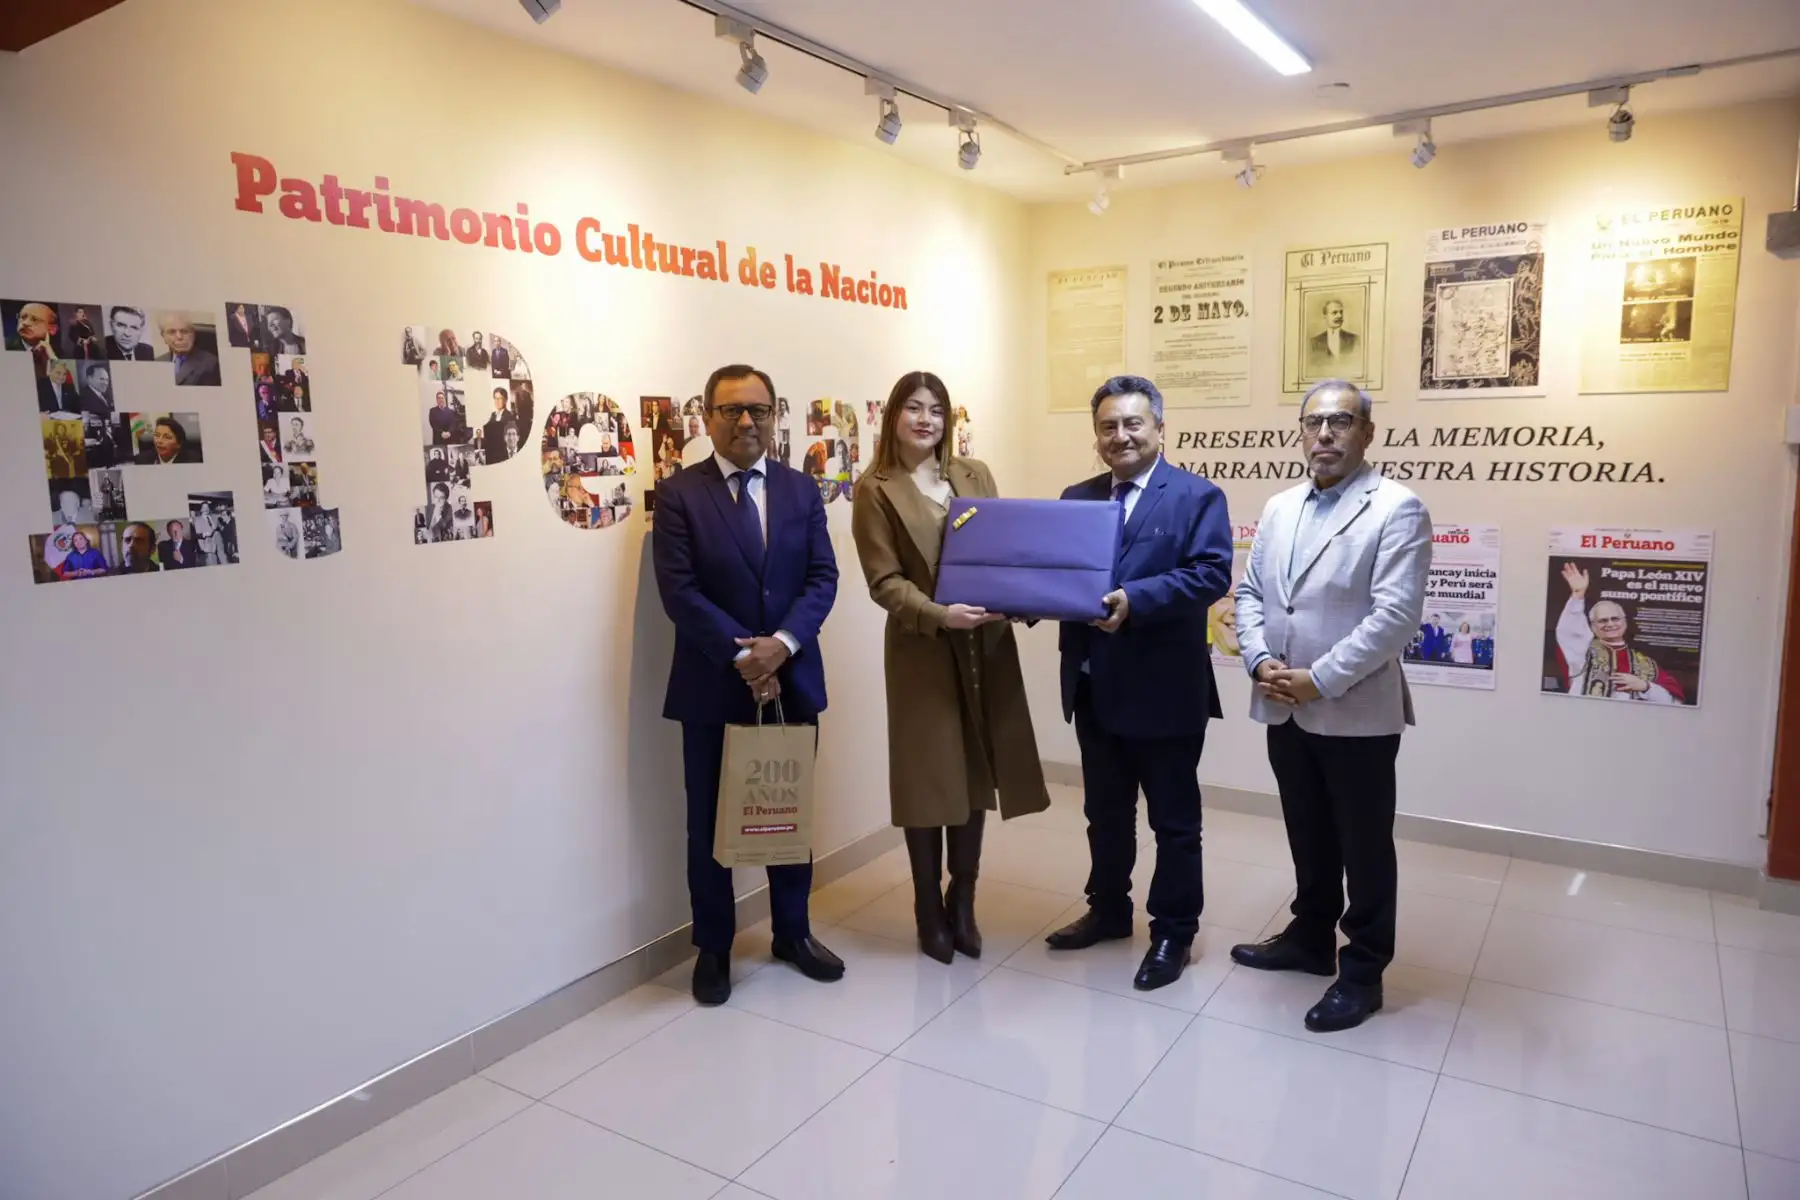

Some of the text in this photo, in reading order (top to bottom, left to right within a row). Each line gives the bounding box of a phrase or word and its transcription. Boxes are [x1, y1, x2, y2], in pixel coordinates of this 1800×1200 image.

[1648, 203, 1733, 222] PERUANO
[230, 151, 908, 311] Patrimonio Cultural de la Nacion
[1442, 229, 1457, 240] EL
[1461, 222, 1529, 238] PERUANO
[1678, 230, 1738, 243] Mundo
[1663, 242, 1738, 255] Hombre
[1320, 250, 1371, 266] Peruano
[1154, 299, 1249, 324] 2 DE MAYO.
[0, 299, 342, 584] El
[1382, 427, 1420, 448] LA
[1430, 425, 1605, 451] MEMORIA,
[1371, 461, 1475, 481] ESTRA
[1486, 461, 1665, 483] HISTORIA.
[1431, 533, 1470, 544] uano
[1580, 534, 1597, 548] El
[1601, 535, 1675, 551] Peruano
[1427, 568, 1497, 578] ancay inicia
[1601, 567, 1705, 582] Papa León XIV
[1430, 580, 1438, 588] y
[1440, 578, 1467, 588] Perú
[1468, 580, 1493, 589] será
[1626, 581, 1704, 592] es el nuevo
[1438, 590, 1486, 600] mundial
[1601, 590, 1702, 603] sumo pontífice
[745, 758, 802, 785] 200
[743, 784, 798, 804] AÑOS
[743, 805, 798, 816] El Peruano
